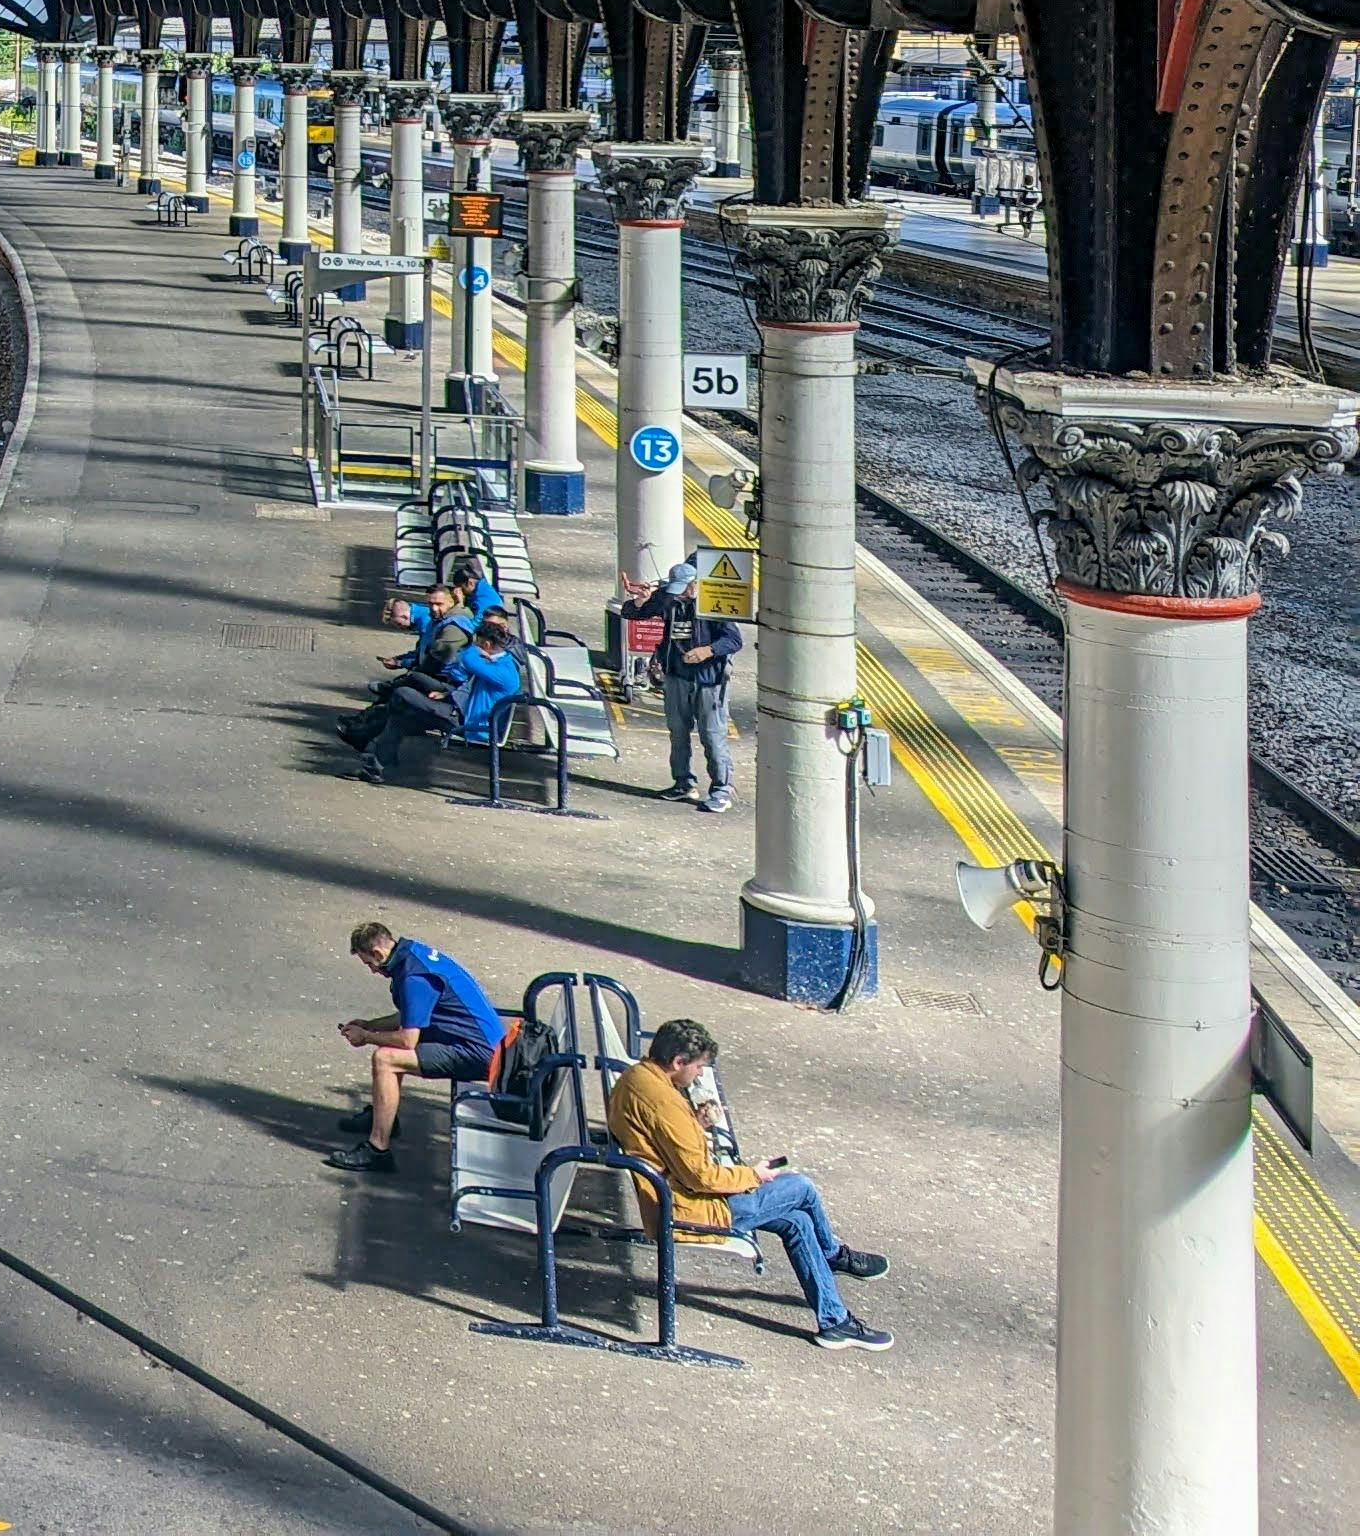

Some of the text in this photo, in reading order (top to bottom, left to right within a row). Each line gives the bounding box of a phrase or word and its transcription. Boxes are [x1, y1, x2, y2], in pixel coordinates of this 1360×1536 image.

[347, 257, 366, 266] Way
[691, 366, 739, 395] 5b
[640, 439, 673, 463] 13
